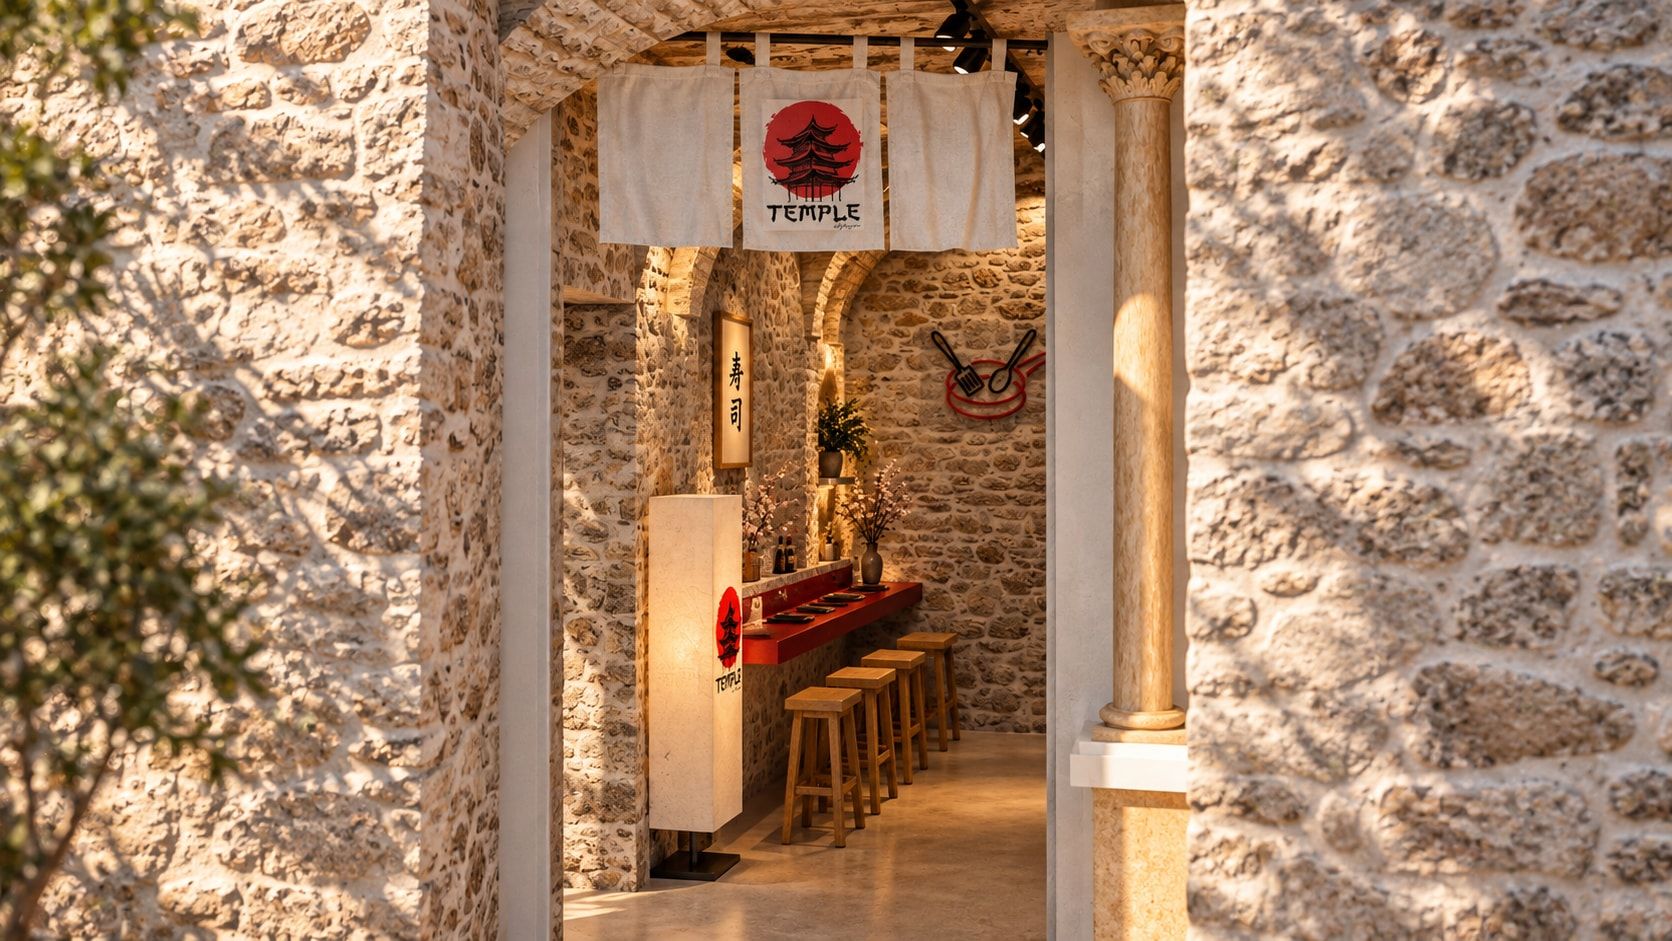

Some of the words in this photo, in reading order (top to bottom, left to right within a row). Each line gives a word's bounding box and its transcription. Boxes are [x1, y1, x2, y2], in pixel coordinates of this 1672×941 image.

[767, 203, 861, 222] TEMPLE
[729, 351, 744, 432] 寿司
[715, 668, 741, 694] TEMPLE
